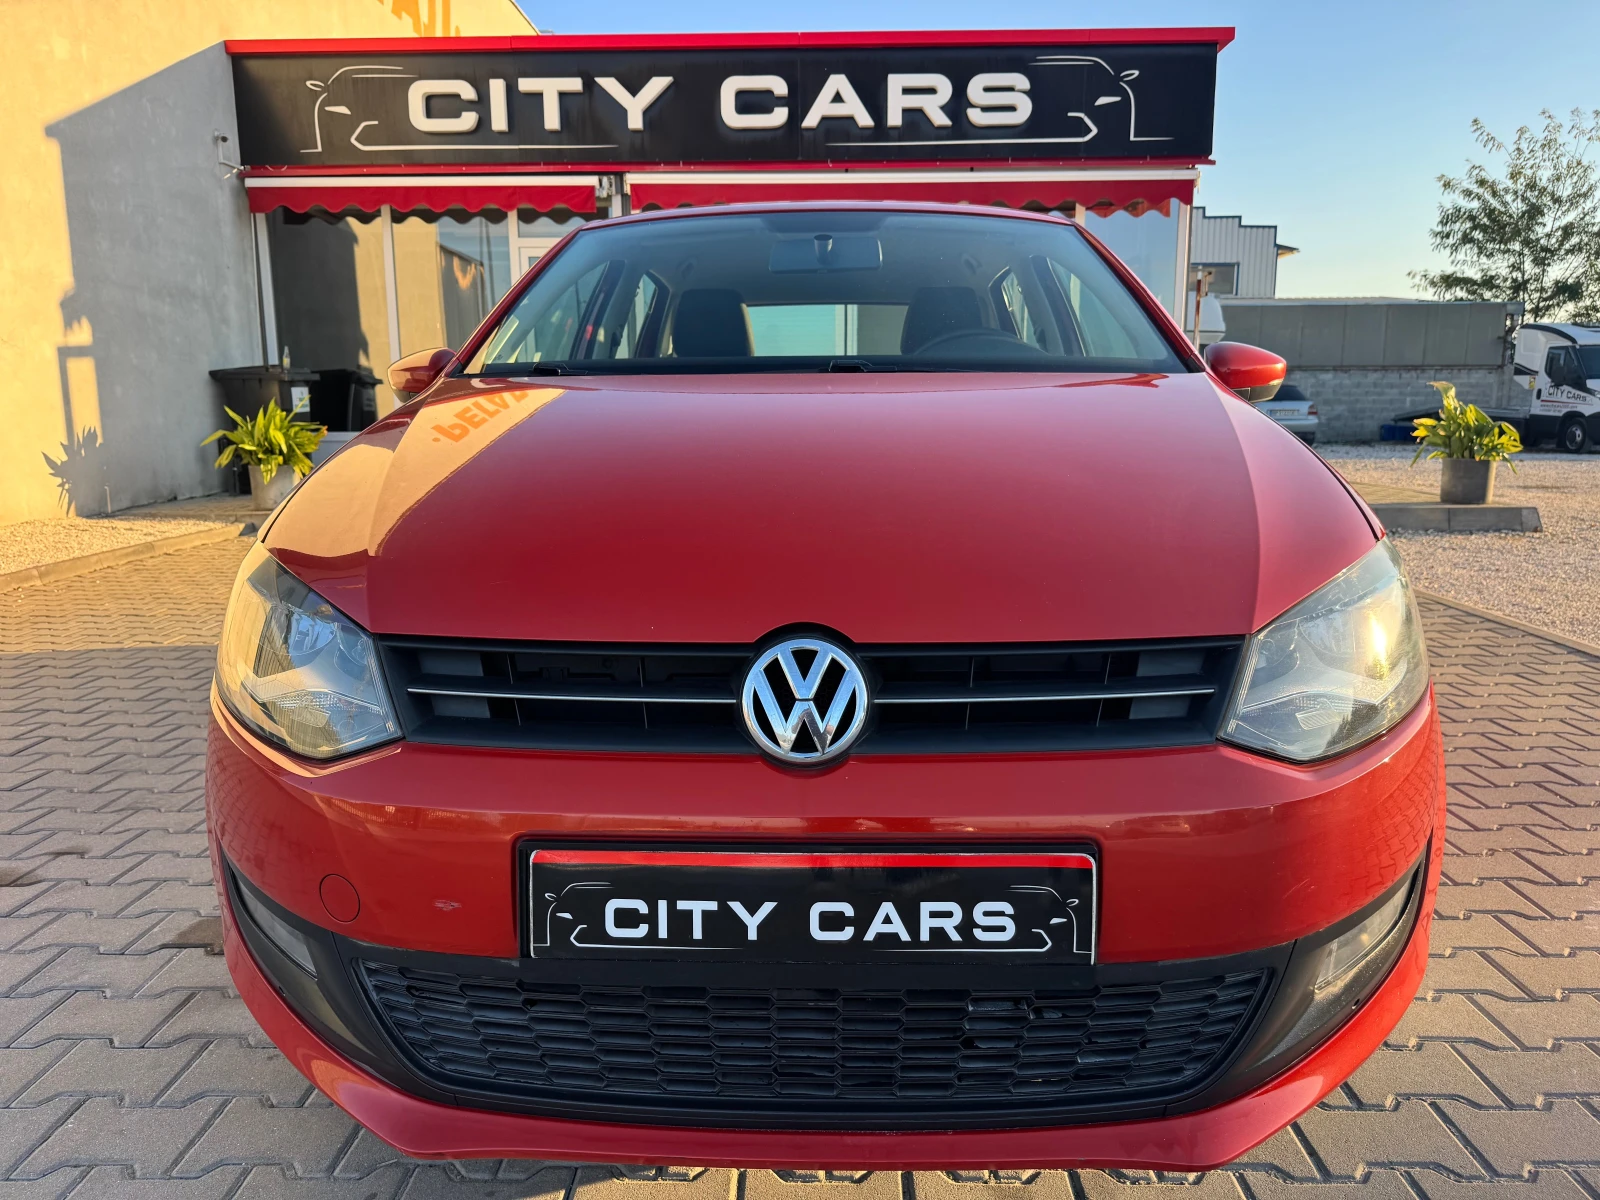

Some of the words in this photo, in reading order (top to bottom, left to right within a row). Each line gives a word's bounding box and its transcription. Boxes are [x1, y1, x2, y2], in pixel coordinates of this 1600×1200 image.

[408, 76, 674, 132] CITY
[720, 73, 1033, 129] CARS
[1547, 386, 1564, 398] CITY
[1566, 391, 1587, 402] CARS
[742, 639, 868, 762] VW
[604, 898, 778, 941] CITY
[809, 901, 1016, 942] CARS
